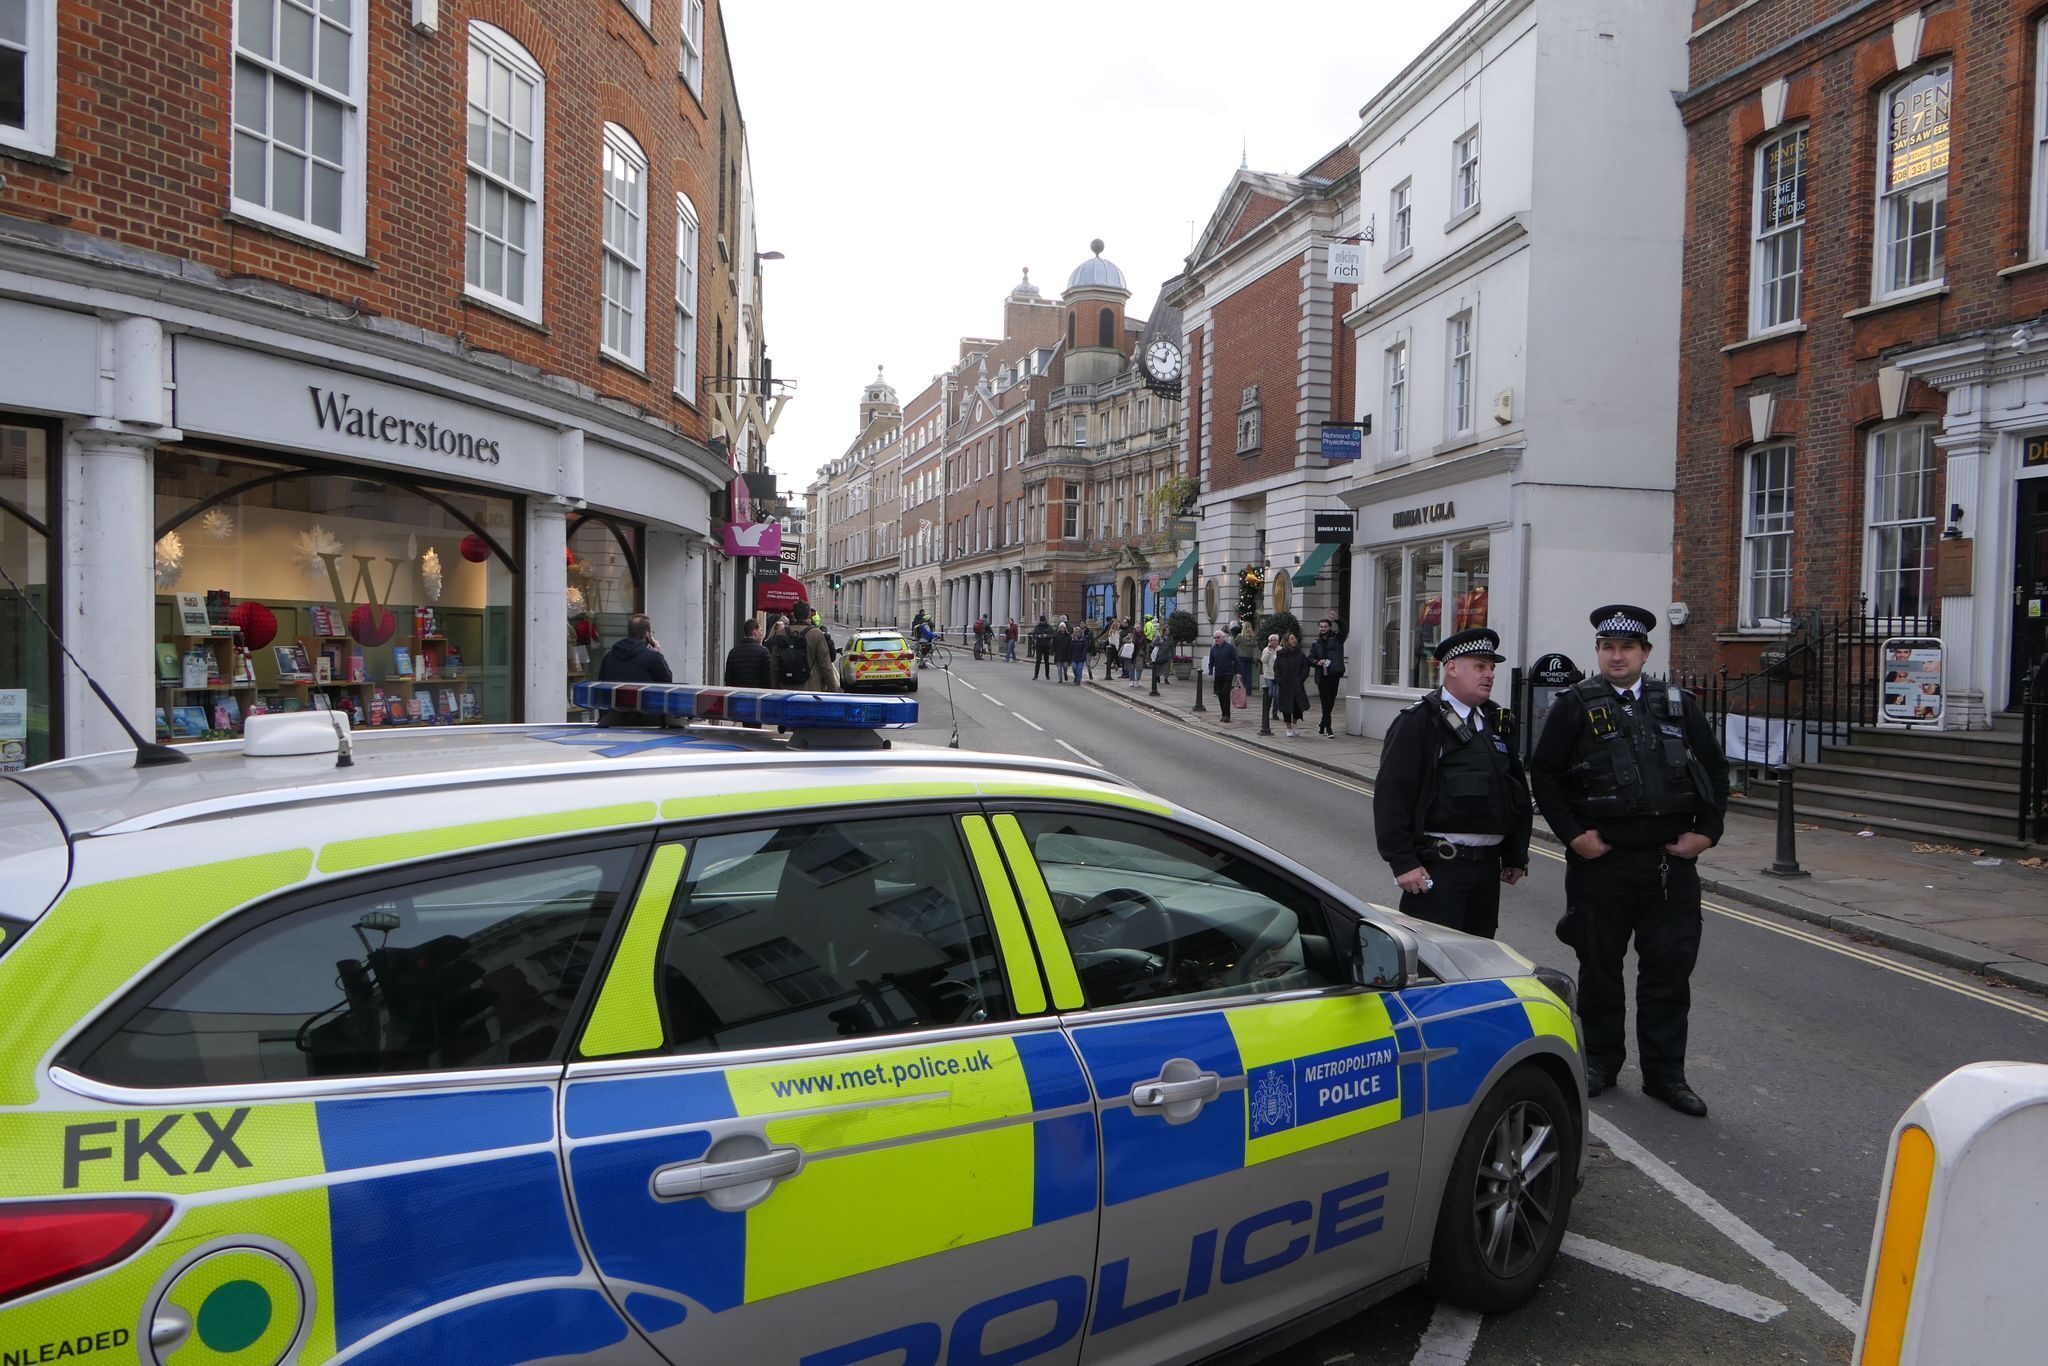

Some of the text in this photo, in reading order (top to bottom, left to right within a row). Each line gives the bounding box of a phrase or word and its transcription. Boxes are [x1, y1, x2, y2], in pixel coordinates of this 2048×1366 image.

[1891, 81, 1950, 119] OPEN
[1923, 122, 1950, 141] WEEK
[1911, 162, 1928, 176] 332
[1334, 264, 1359, 277] rich
[308, 386, 501, 465] Waterstones
[708, 392, 793, 446] W
[1322, 432, 1350, 440] Richmond
[1322, 439, 1361, 447] Physiotherapy
[1393, 508, 1422, 529] BIMBA
[1429, 501, 1455, 523] LOLA
[781, 551, 796, 561] NGS
[317, 552, 405, 633] W
[770, 1050, 994, 1099] www.met.police.uk
[1305, 1049, 1392, 1083] METROPOLITAN
[1319, 1075, 1381, 1107] POLICE
[63, 1107, 254, 1189] FKX
[0, 1328, 129, 1366] NLEADED
